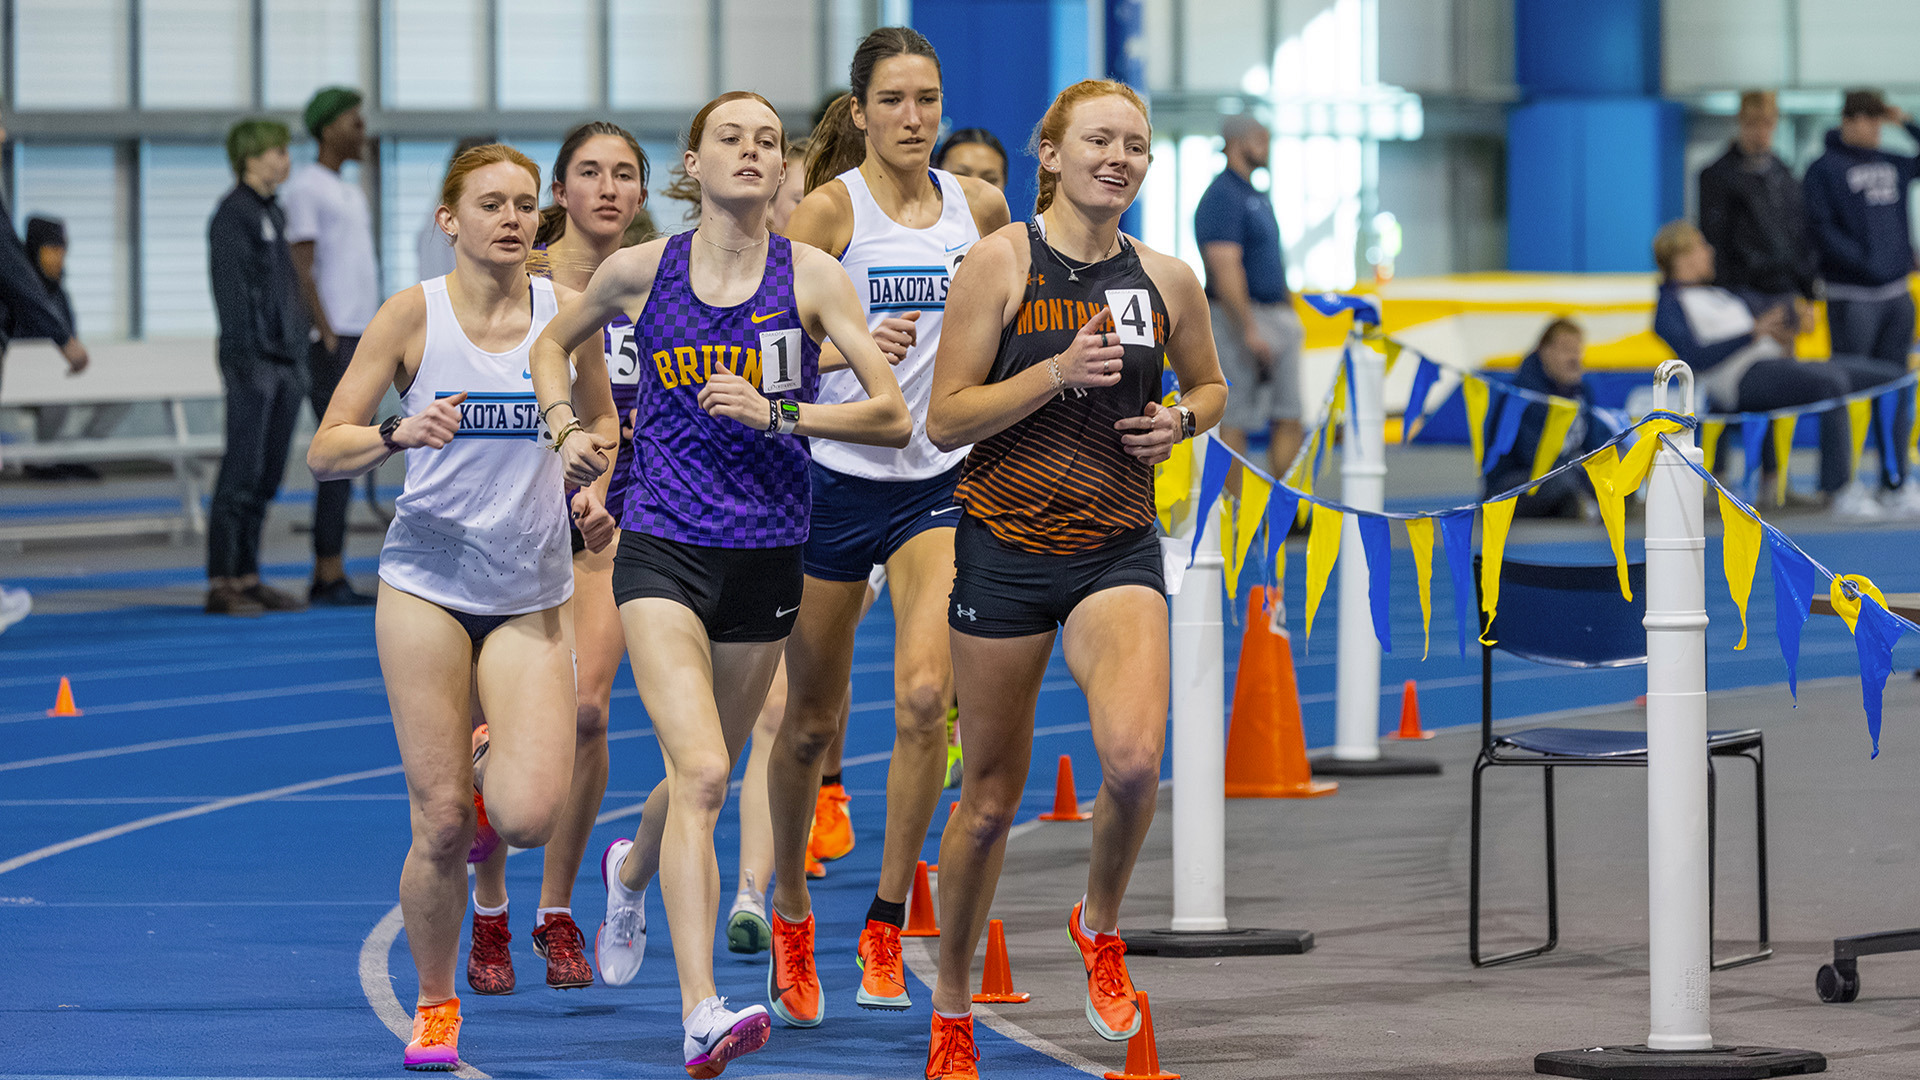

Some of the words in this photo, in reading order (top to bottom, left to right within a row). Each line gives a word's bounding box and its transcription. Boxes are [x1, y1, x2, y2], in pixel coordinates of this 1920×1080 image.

[868, 277, 935, 303] DAKOTA
[1121, 294, 1147, 336] 4
[618, 334, 638, 377] 5
[652, 345, 764, 390] BRUIN
[770, 336, 793, 384] 1
[459, 403, 508, 429] KOTA
[512, 403, 542, 429] STA
